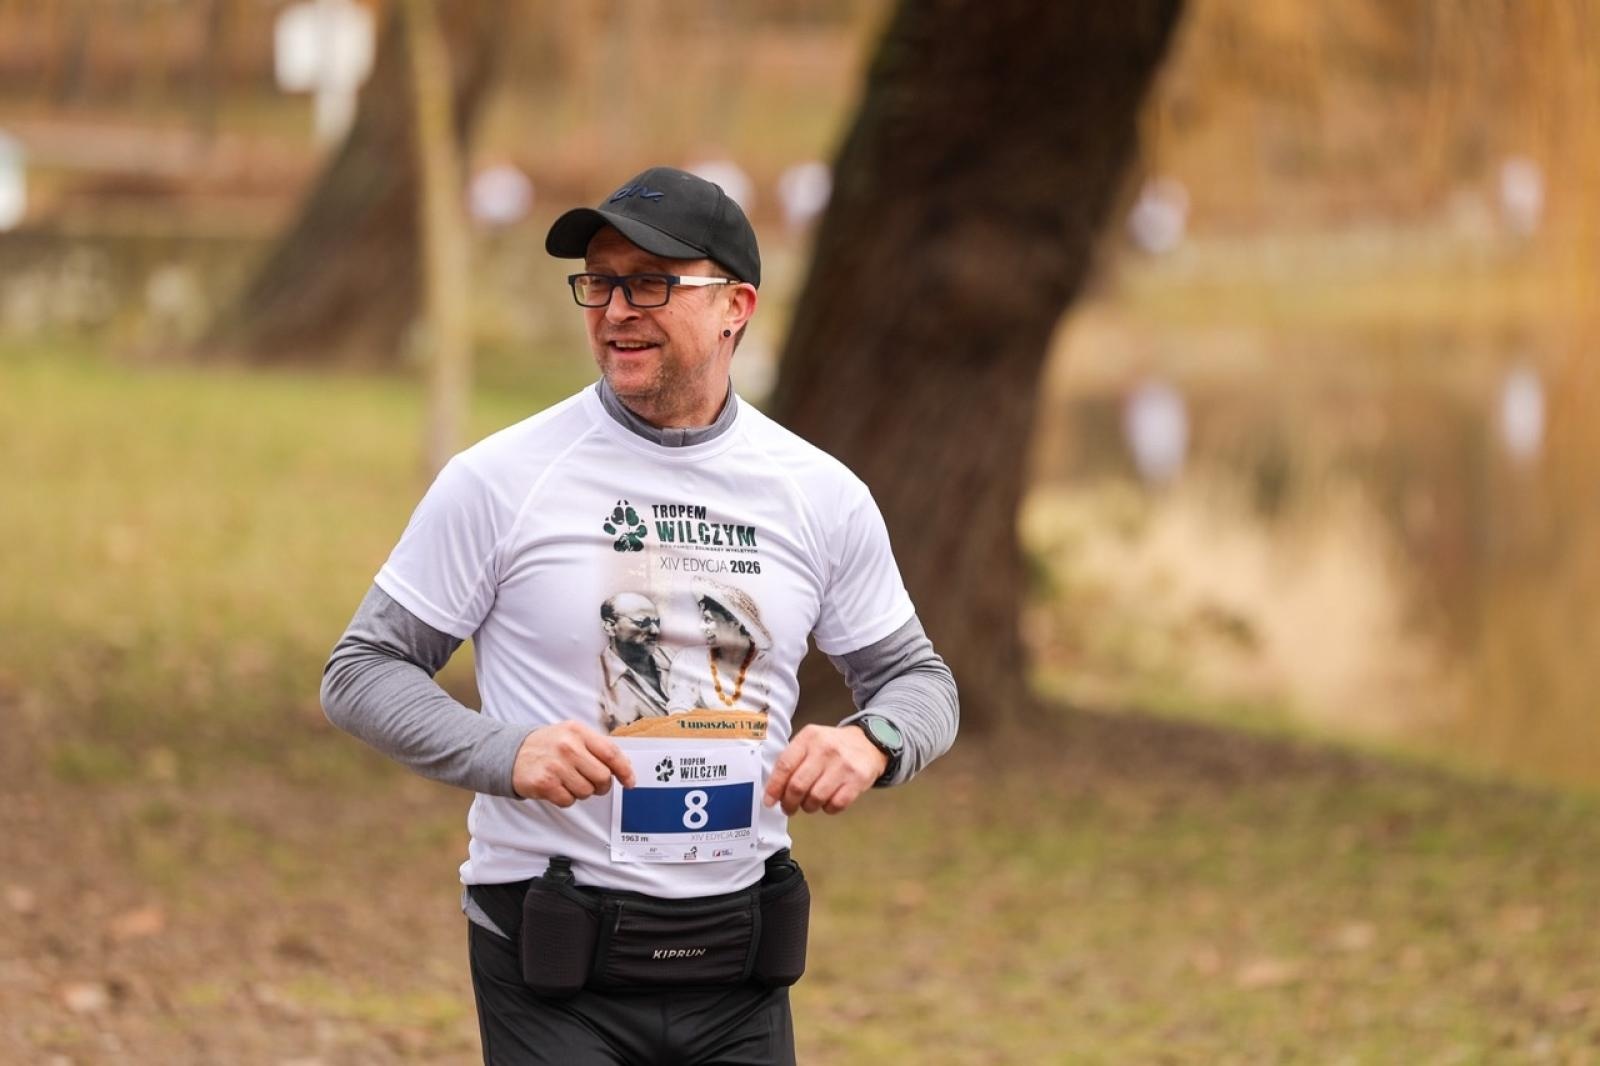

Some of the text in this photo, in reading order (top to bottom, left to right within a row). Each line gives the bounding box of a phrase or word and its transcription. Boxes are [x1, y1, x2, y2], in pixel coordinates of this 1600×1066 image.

[652, 504, 707, 520] TROPEM
[655, 520, 757, 547] WILCZYM
[660, 556, 761, 574] XIV EDYCJA 2026
[680, 757, 706, 766] TROPEM
[680, 764, 727, 780] WILCZYM
[682, 789, 709, 830] 8
[621, 834, 639, 842] 1963
[652, 948, 707, 960] KIPRUN
